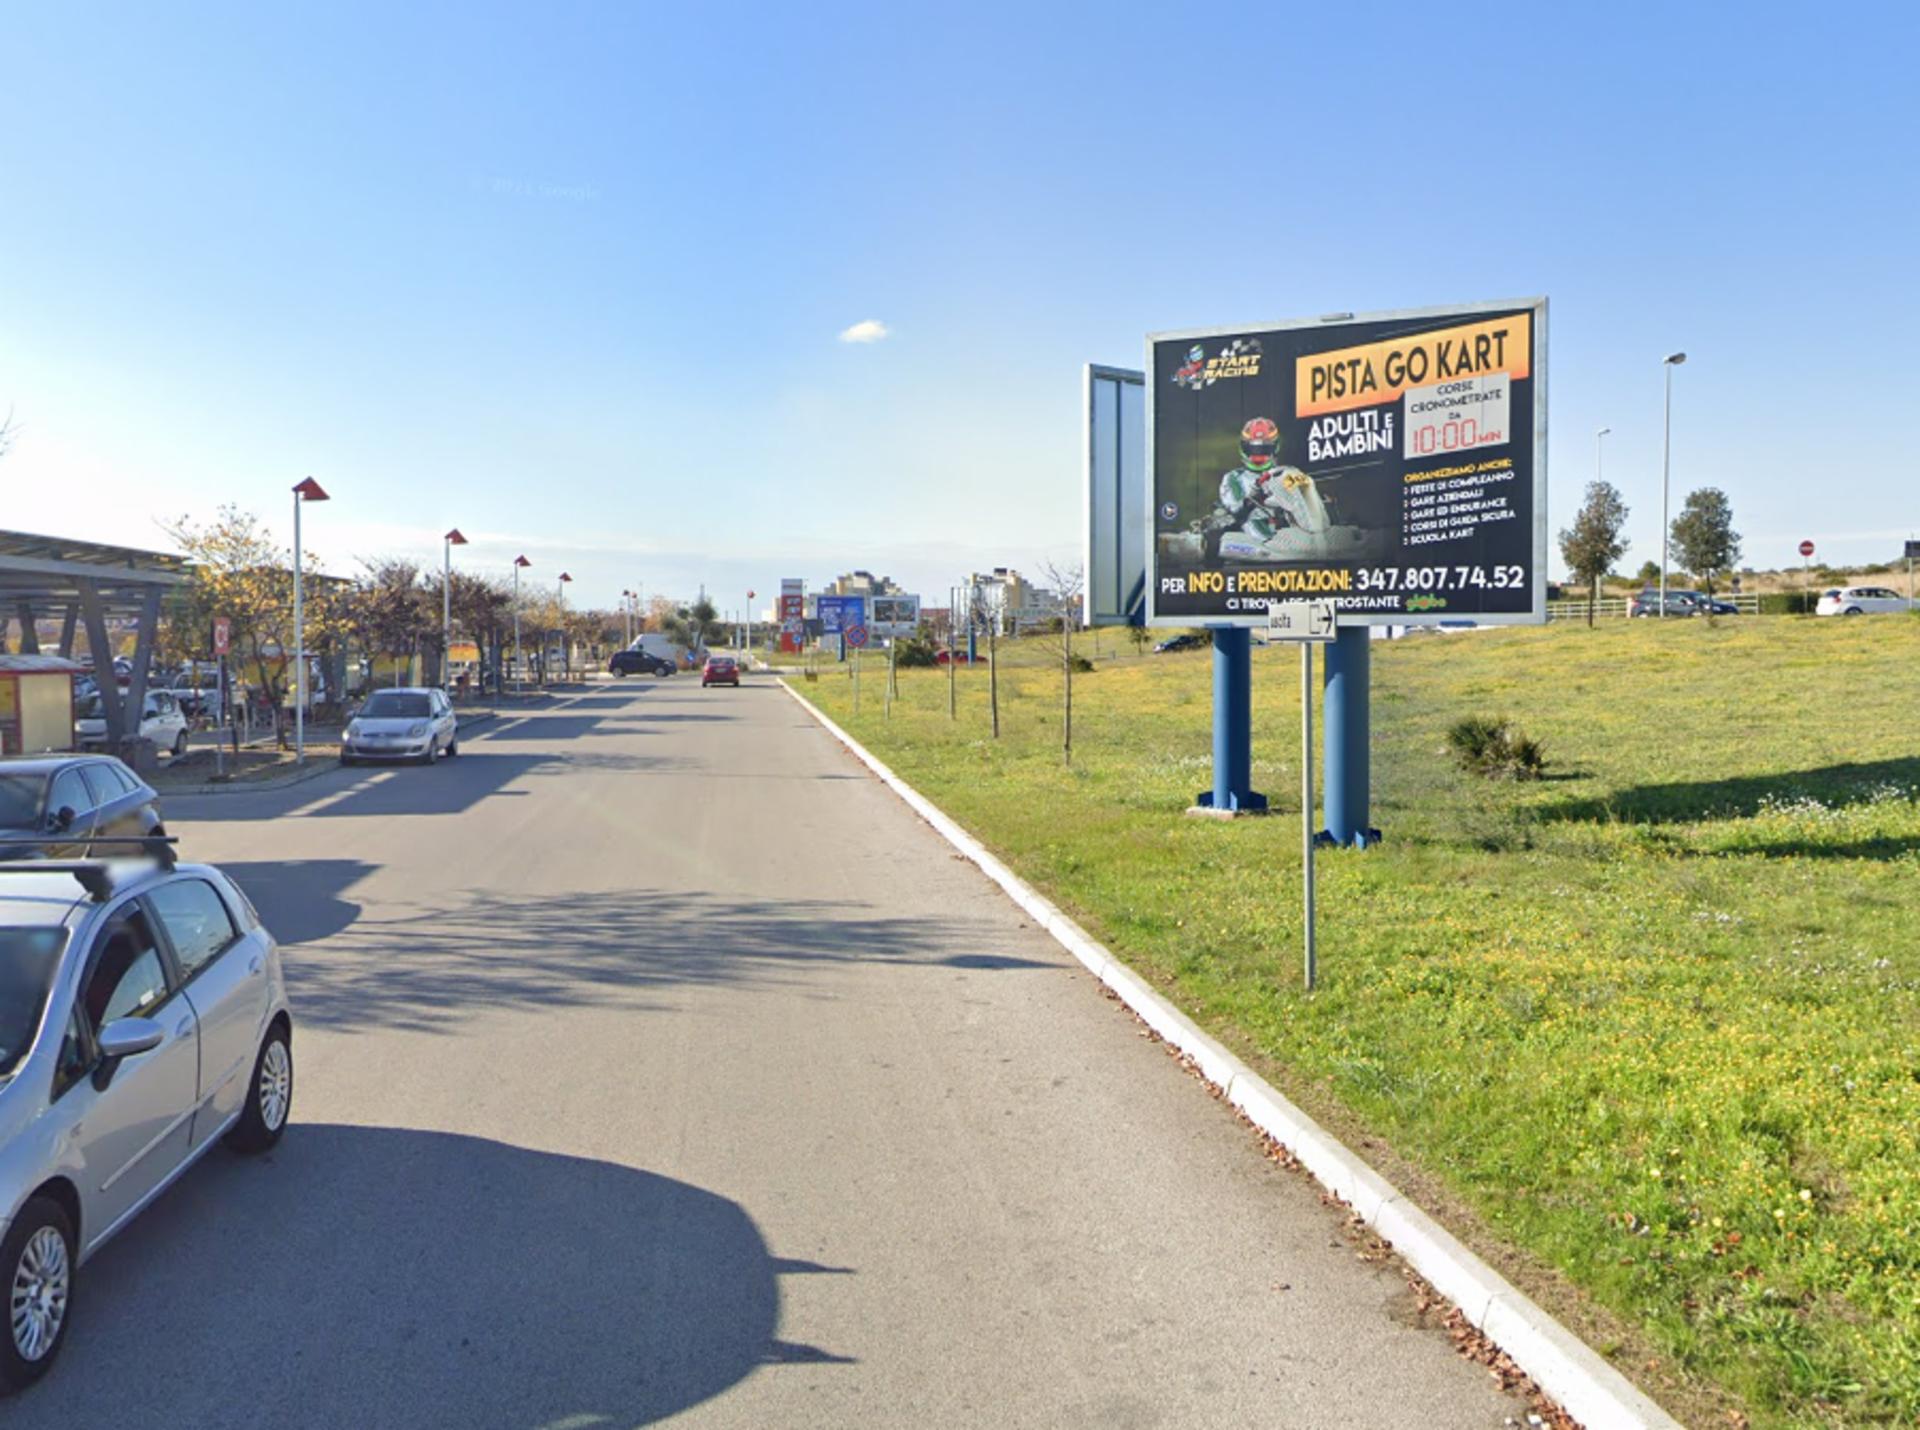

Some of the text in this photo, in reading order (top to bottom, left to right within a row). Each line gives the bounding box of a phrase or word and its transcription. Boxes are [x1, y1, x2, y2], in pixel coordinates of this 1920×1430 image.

[1207, 355, 1261, 369] START
[1310, 329, 1508, 402] PISTA GO KART
[1437, 380, 1474, 396] CORSE
[1410, 388, 1502, 413] CRONOMETRATE
[1308, 409, 1394, 441] ADULTI E
[1413, 418, 1477, 453] 10:00
[1308, 429, 1394, 462] BAMBINI
[1448, 470, 1515, 489] COMPLEANNO
[1410, 488, 1484, 507] GARE AZIENDALI
[1410, 508, 1435, 520] GARE
[1450, 497, 1507, 514] ENDURANCE
[1410, 520, 1437, 532] CORSI
[1449, 515, 1480, 527] GUIDA
[1481, 510, 1516, 522] SICURA
[1410, 527, 1475, 545] SCUOLA KART
[1161, 566, 1525, 594] PER INFO E PRENOTAZIONI: 347.807.74.52
[1226, 597, 1240, 610] CI
